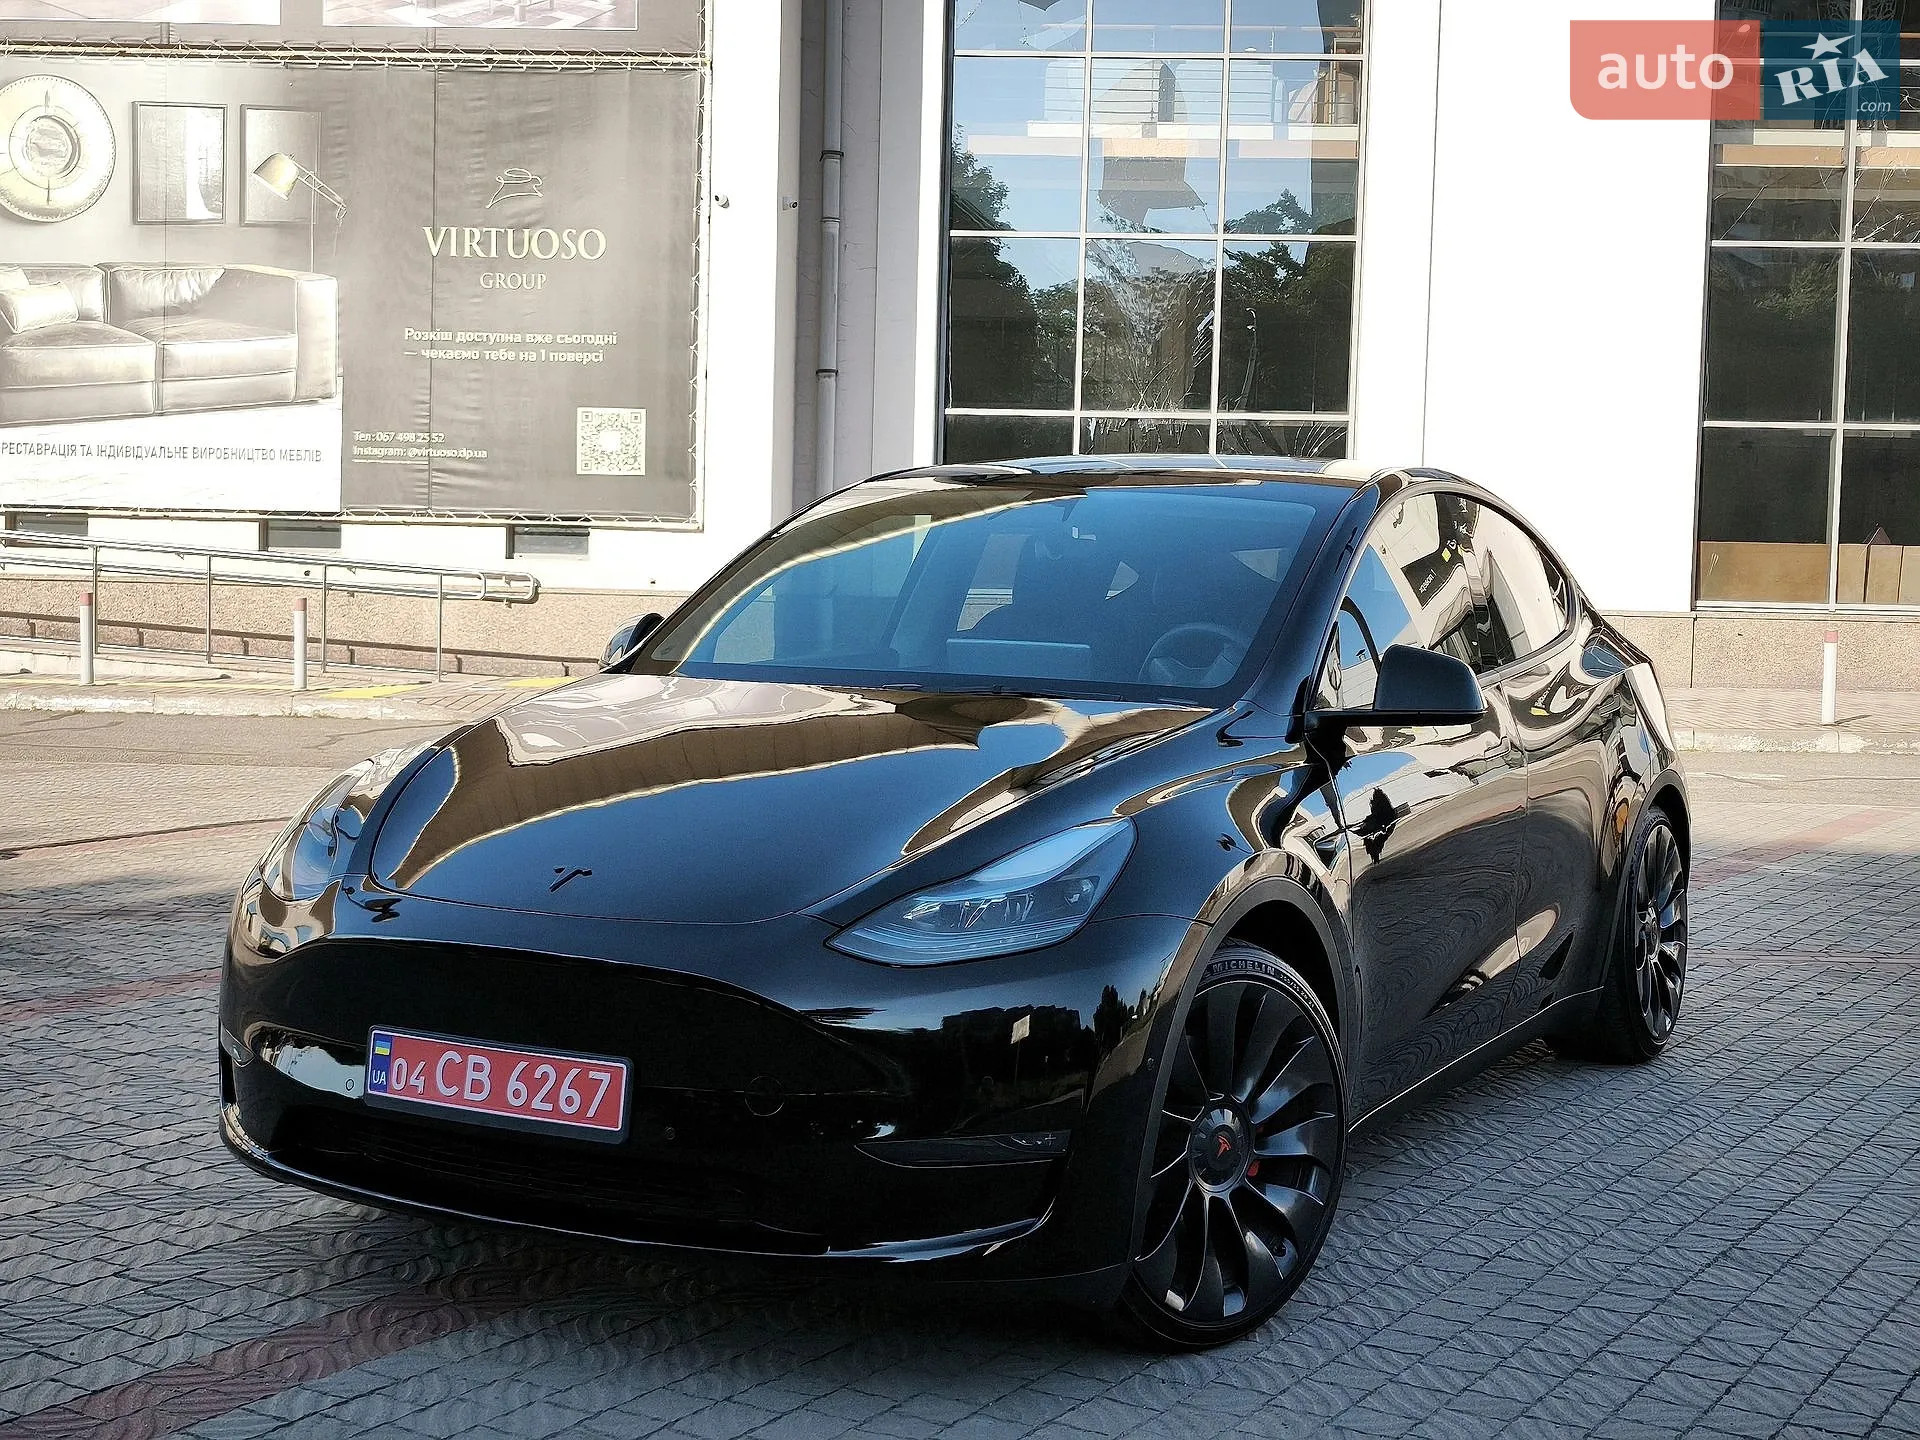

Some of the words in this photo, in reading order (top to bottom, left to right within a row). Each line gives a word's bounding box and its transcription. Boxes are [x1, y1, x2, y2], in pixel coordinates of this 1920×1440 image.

[422, 226, 607, 260] VIRTUOSO
[479, 272, 548, 290] GROUP
[404, 327, 453, 342] Розкіш
[456, 331, 522, 345] доступна
[525, 333, 553, 344] вже
[556, 331, 618, 346] сьогодні
[421, 350, 480, 361] чекаємо
[483, 348, 516, 361] тебе
[519, 352, 537, 362] на
[539, 349, 546, 361] 1
[549, 350, 604, 364] поверсі
[1, 442, 77, 458] РЕСТАВРАЦІЯ
[80, 444, 93, 457] ТА
[96, 444, 189, 460] ІНДИВІДУАЛЬНЕ
[192, 446, 276, 462] ВИРОБНИЦТВО
[353, 445, 407, 458] Instagram:
[1212, 960, 1276, 976] MICHELIN
[372, 1069, 387, 1085] UA
[391, 1057, 426, 1095] 04
[435, 1050, 492, 1102] CB
[506, 1060, 612, 1118] 6267
